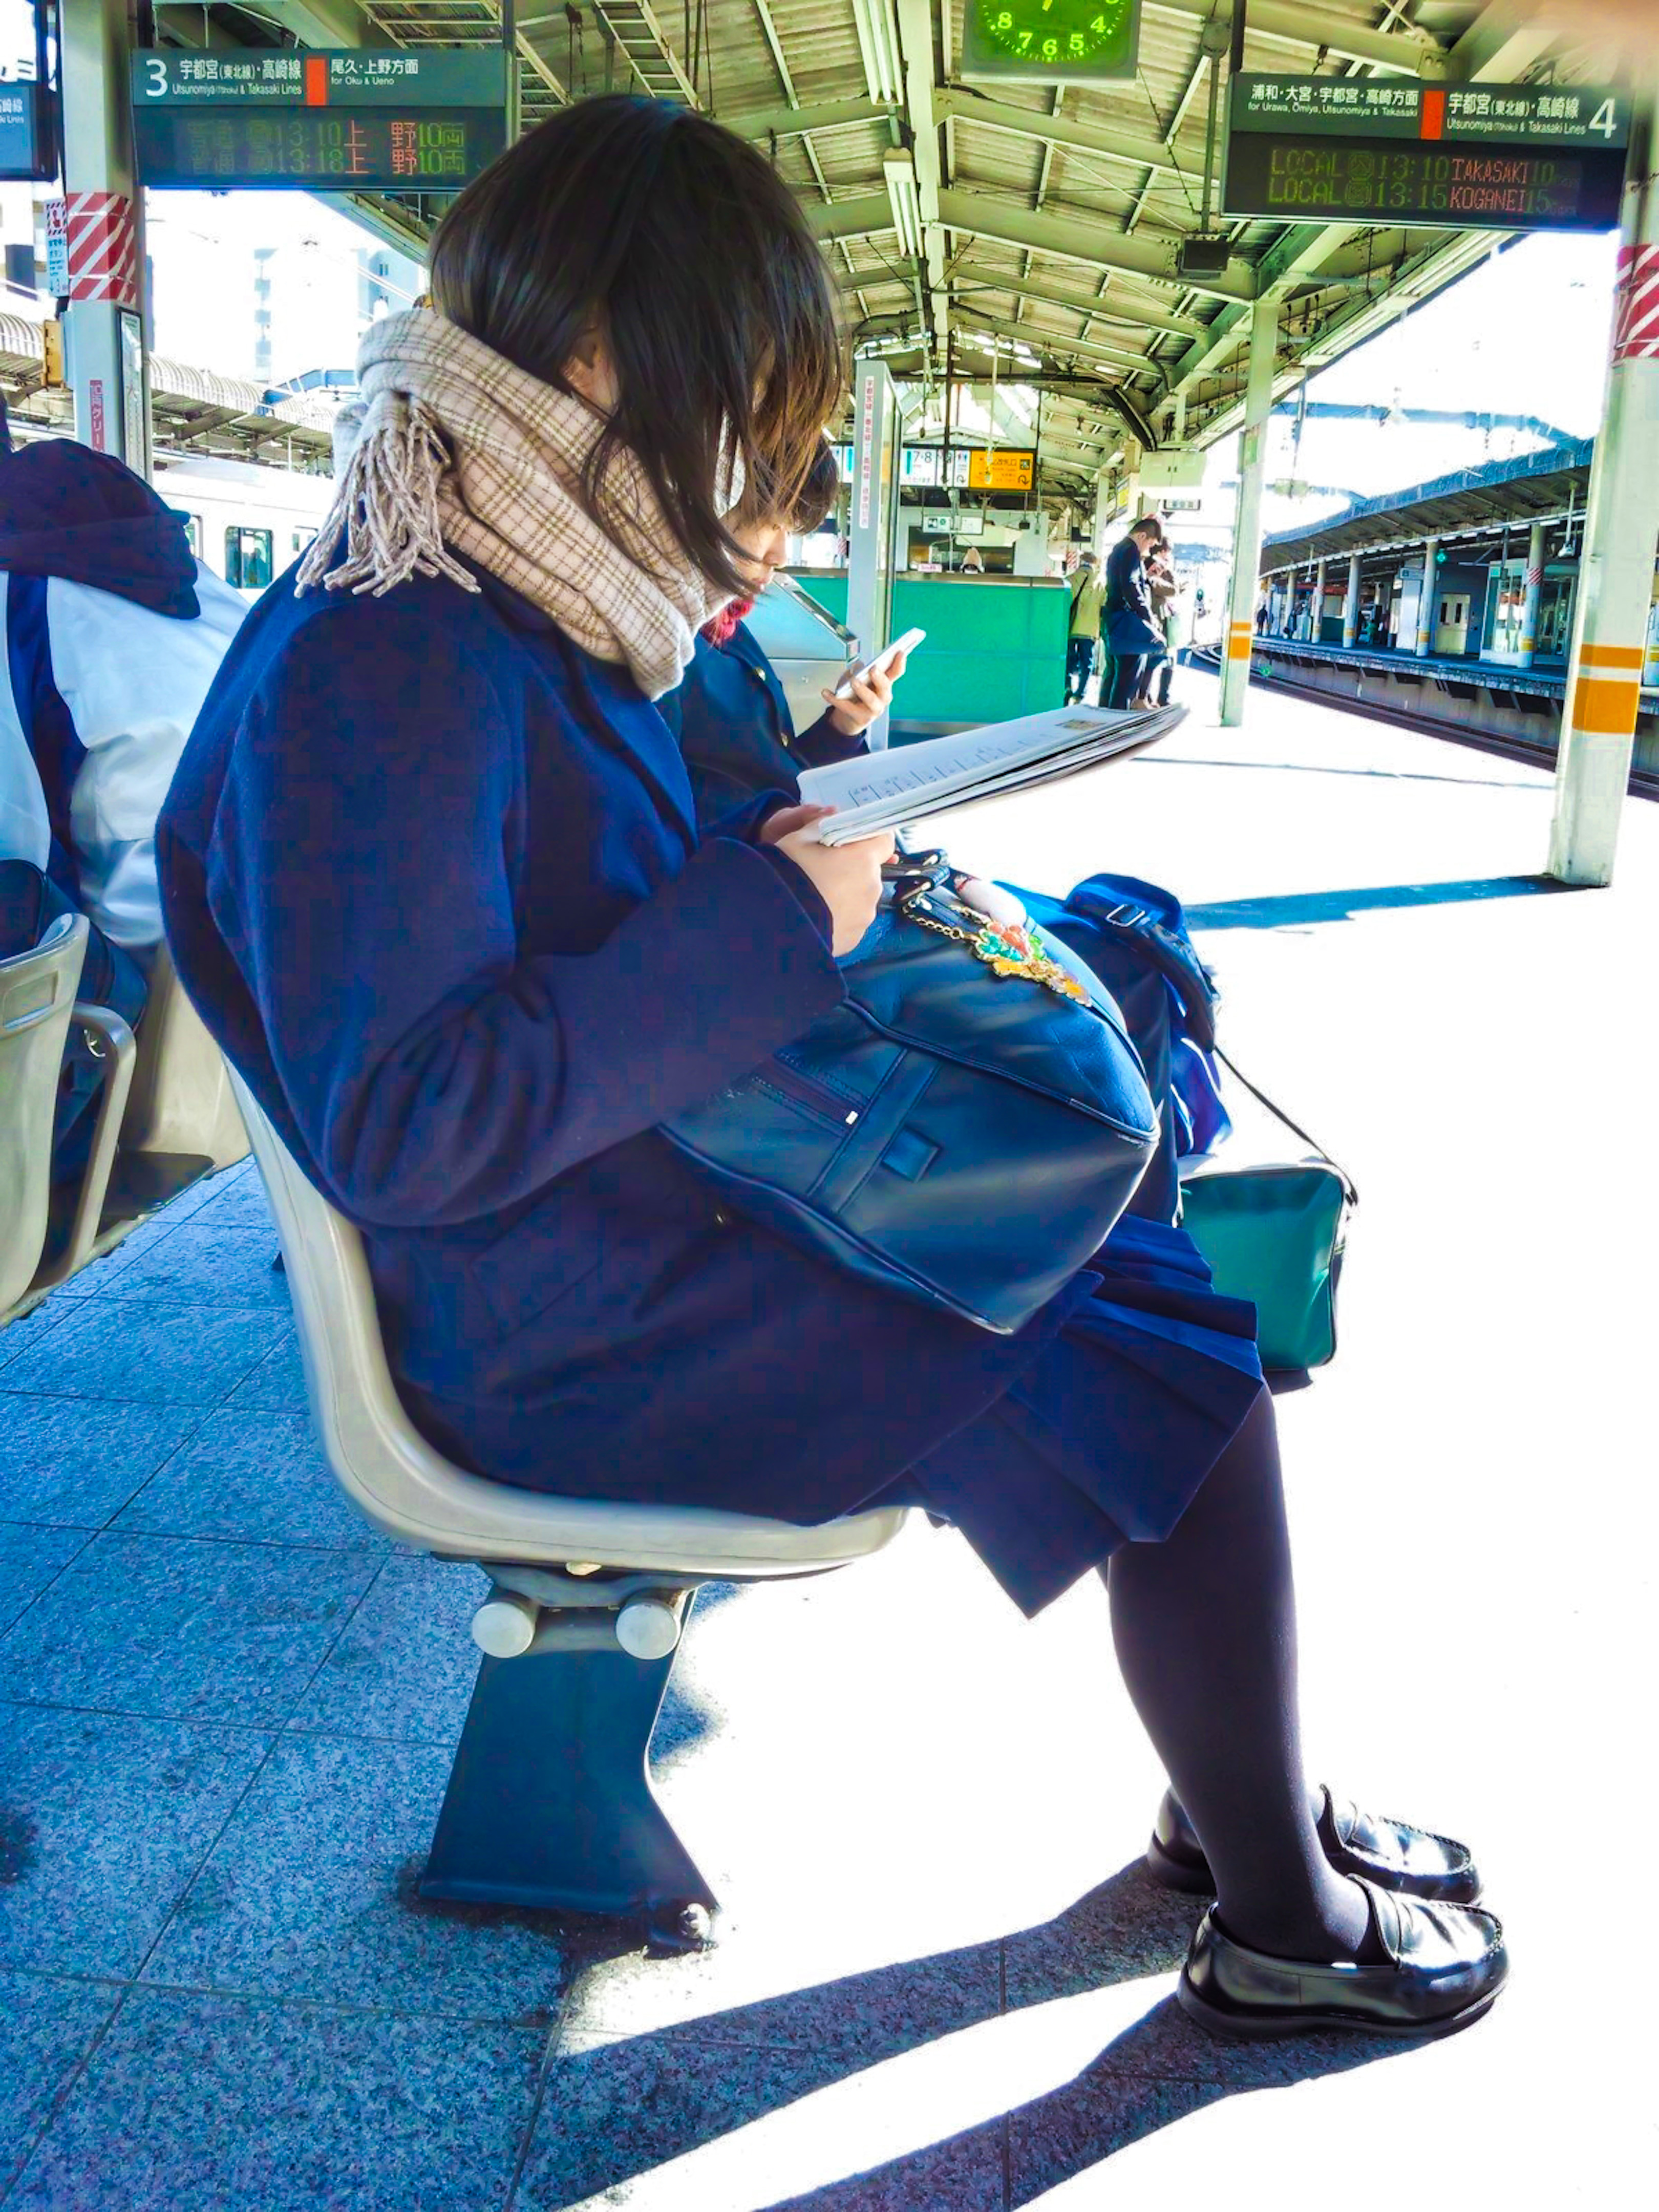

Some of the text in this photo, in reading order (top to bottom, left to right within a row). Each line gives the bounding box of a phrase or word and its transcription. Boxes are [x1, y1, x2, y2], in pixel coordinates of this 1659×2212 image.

[998, 12, 1012, 29] 8
[1090, 15, 1106, 33] 4
[1018, 32, 1033, 49] 7
[1043, 39, 1057, 56] 6
[1070, 33, 1084, 51] 5
[145, 58, 168, 96] 3
[331, 76, 343, 85] for
[345, 76, 363, 85] Oku
[372, 77, 395, 85] Ueno
[247, 82, 280, 95] Takasaki
[281, 83, 302, 95] Lines
[1248, 102, 1260, 111] for
[1383, 108, 1418, 117] Takasaki
[1588, 97, 1617, 139] 4
[1528, 120, 1562, 134] Takasaki
[1564, 122, 1586, 135] Lines
[1270, 149, 1344, 178] LOCAL
[1451, 158, 1528, 185] TAKASAKI
[1268, 177, 1343, 204] LOCAL
[1450, 185, 1527, 211] KOGANEI
